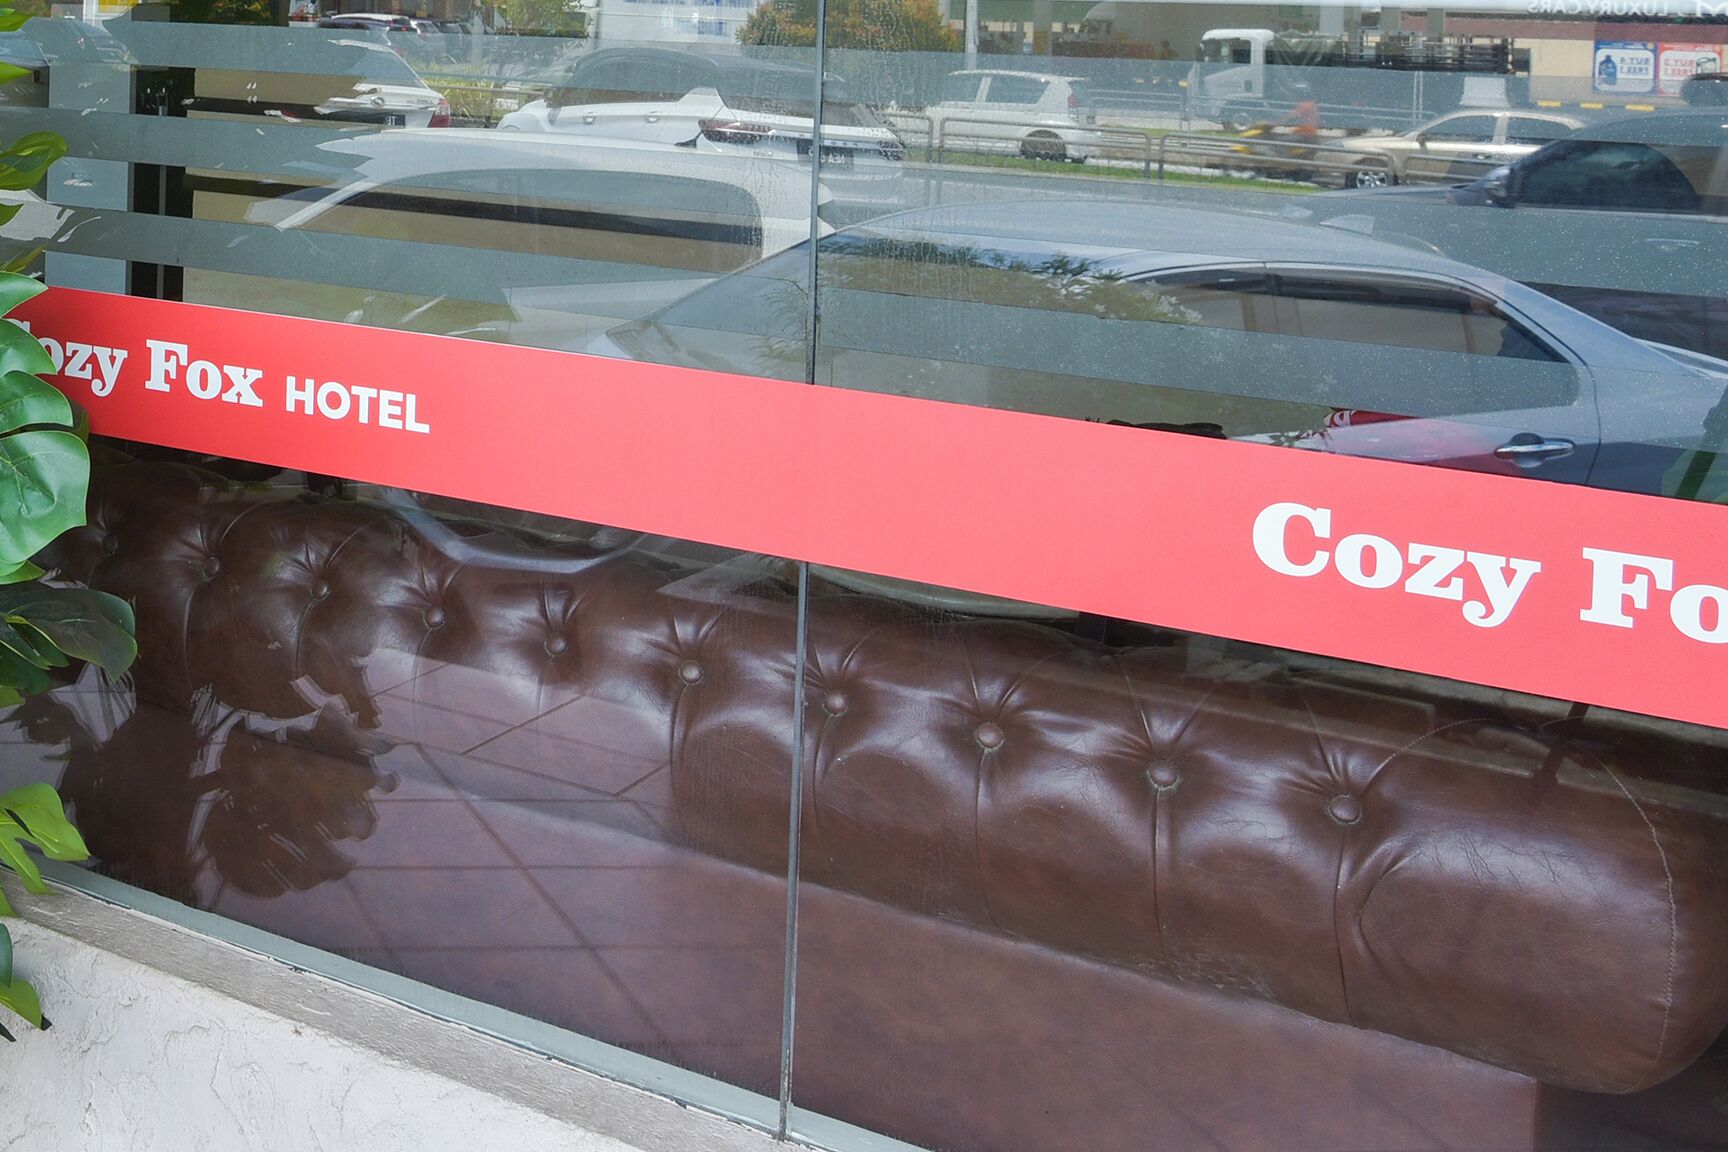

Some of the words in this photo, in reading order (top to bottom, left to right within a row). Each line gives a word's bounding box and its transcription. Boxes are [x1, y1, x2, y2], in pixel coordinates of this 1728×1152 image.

[4, 316, 128, 397] ozy
[145, 338, 264, 407] Fox
[285, 375, 430, 433] HOTEL
[1252, 502, 1541, 628] Cozy
[1579, 547, 1728, 645] Fo
